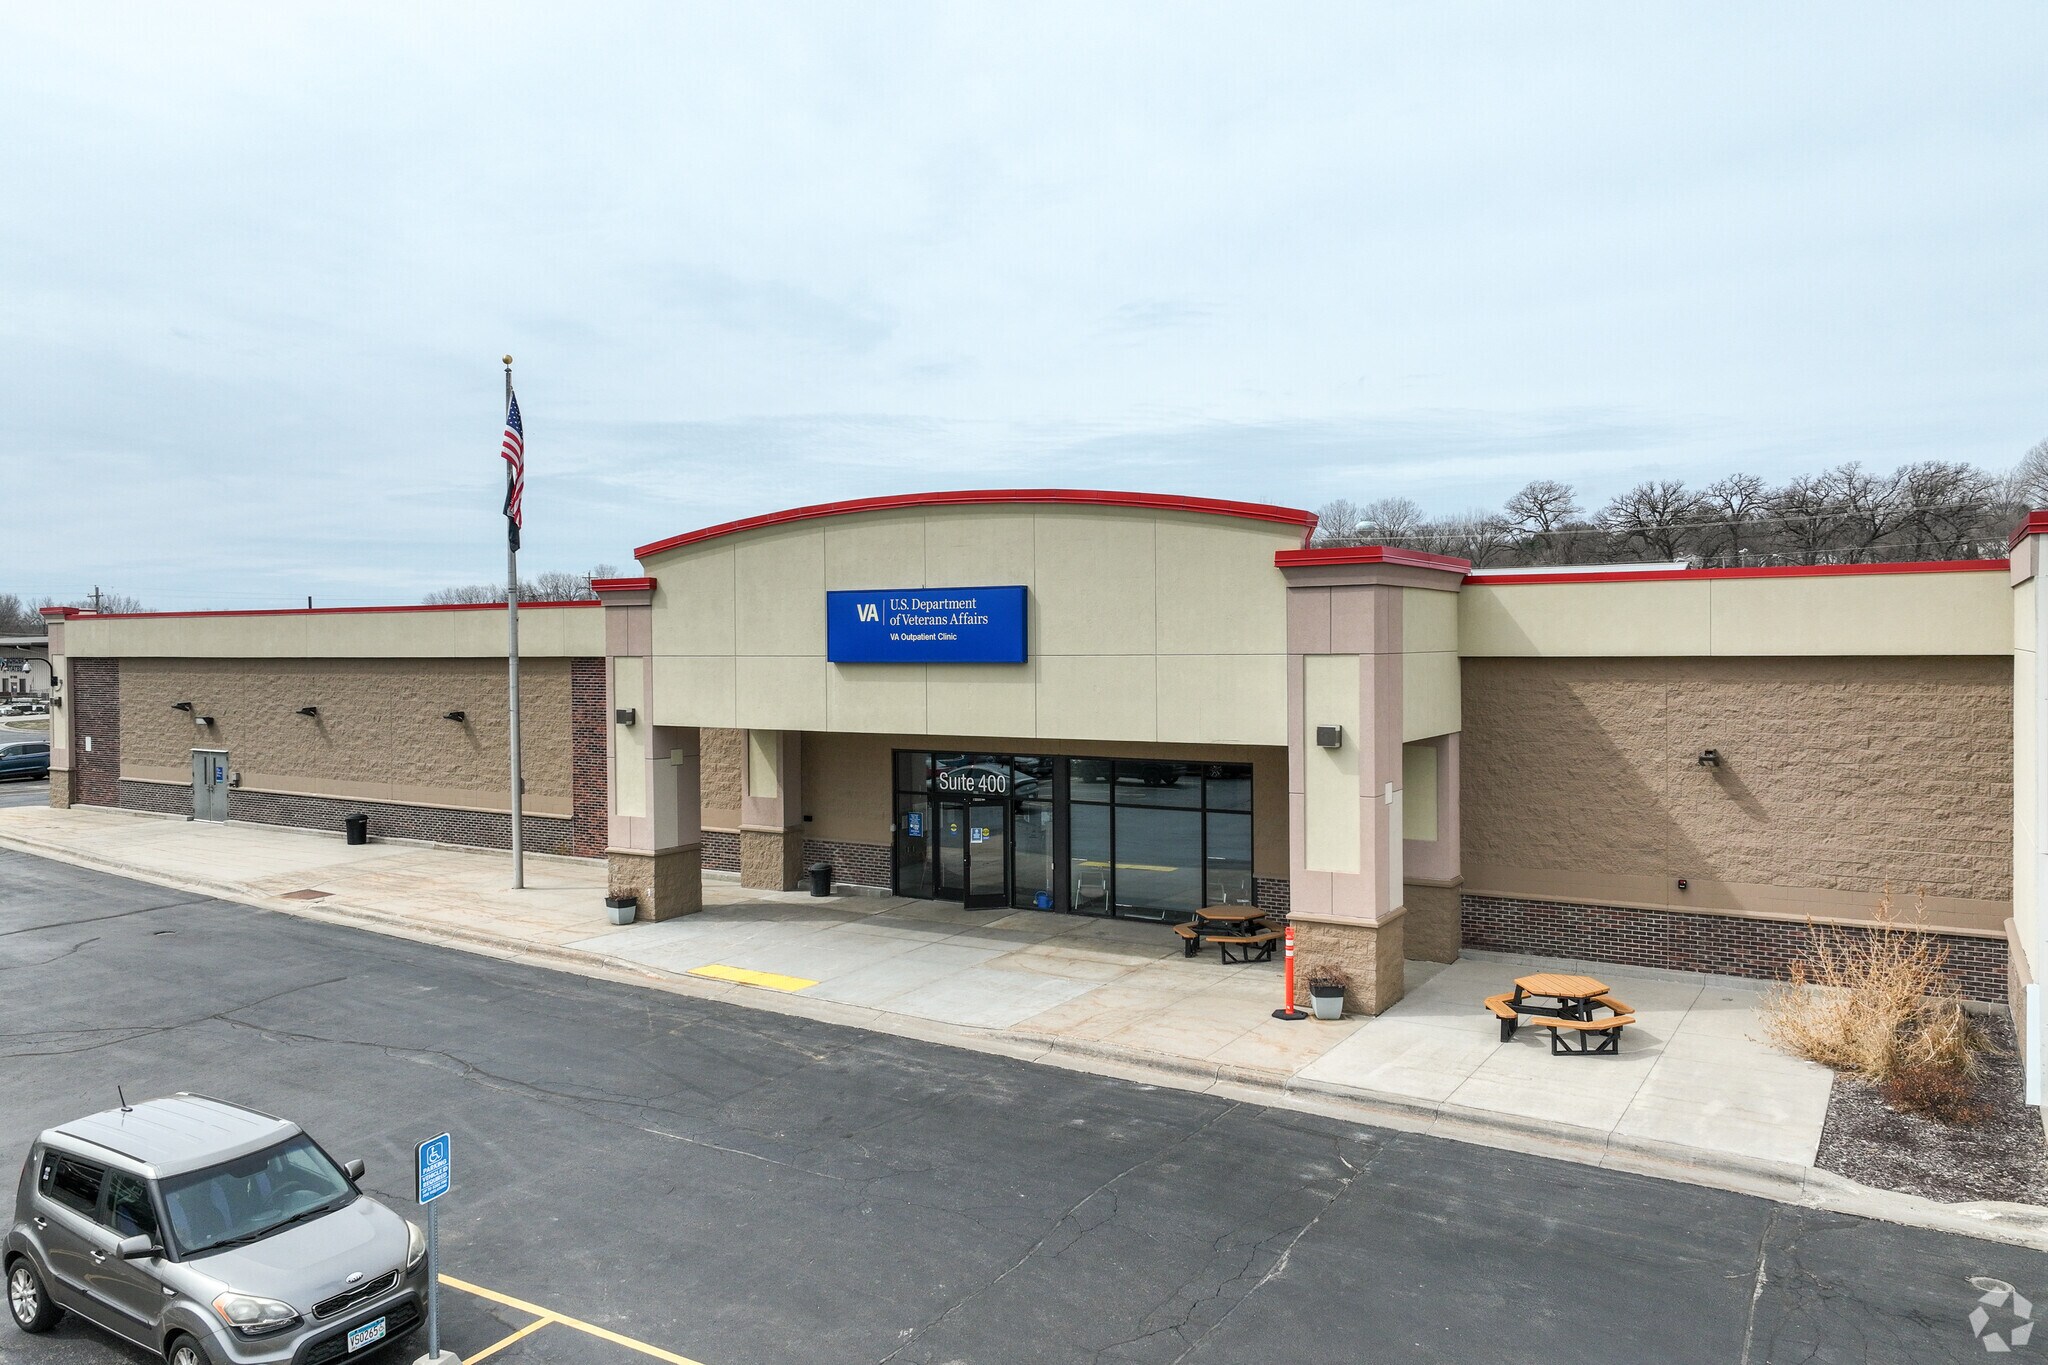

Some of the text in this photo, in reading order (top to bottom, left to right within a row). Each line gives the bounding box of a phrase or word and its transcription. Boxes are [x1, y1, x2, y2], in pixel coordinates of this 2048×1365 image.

[857, 604, 879, 622] VA
[890, 597, 976, 613] U.S. Department
[890, 612, 988, 626] of Veterans Affairs
[900, 633, 936, 642] Outpatient
[937, 632, 957, 640] Clinic
[940, 772, 1006, 793] Suite 400
[422, 1159, 447, 1175] PARKING
[422, 1169, 442, 1182] VEHICLE
[422, 1172, 448, 1188] REQUIRED
